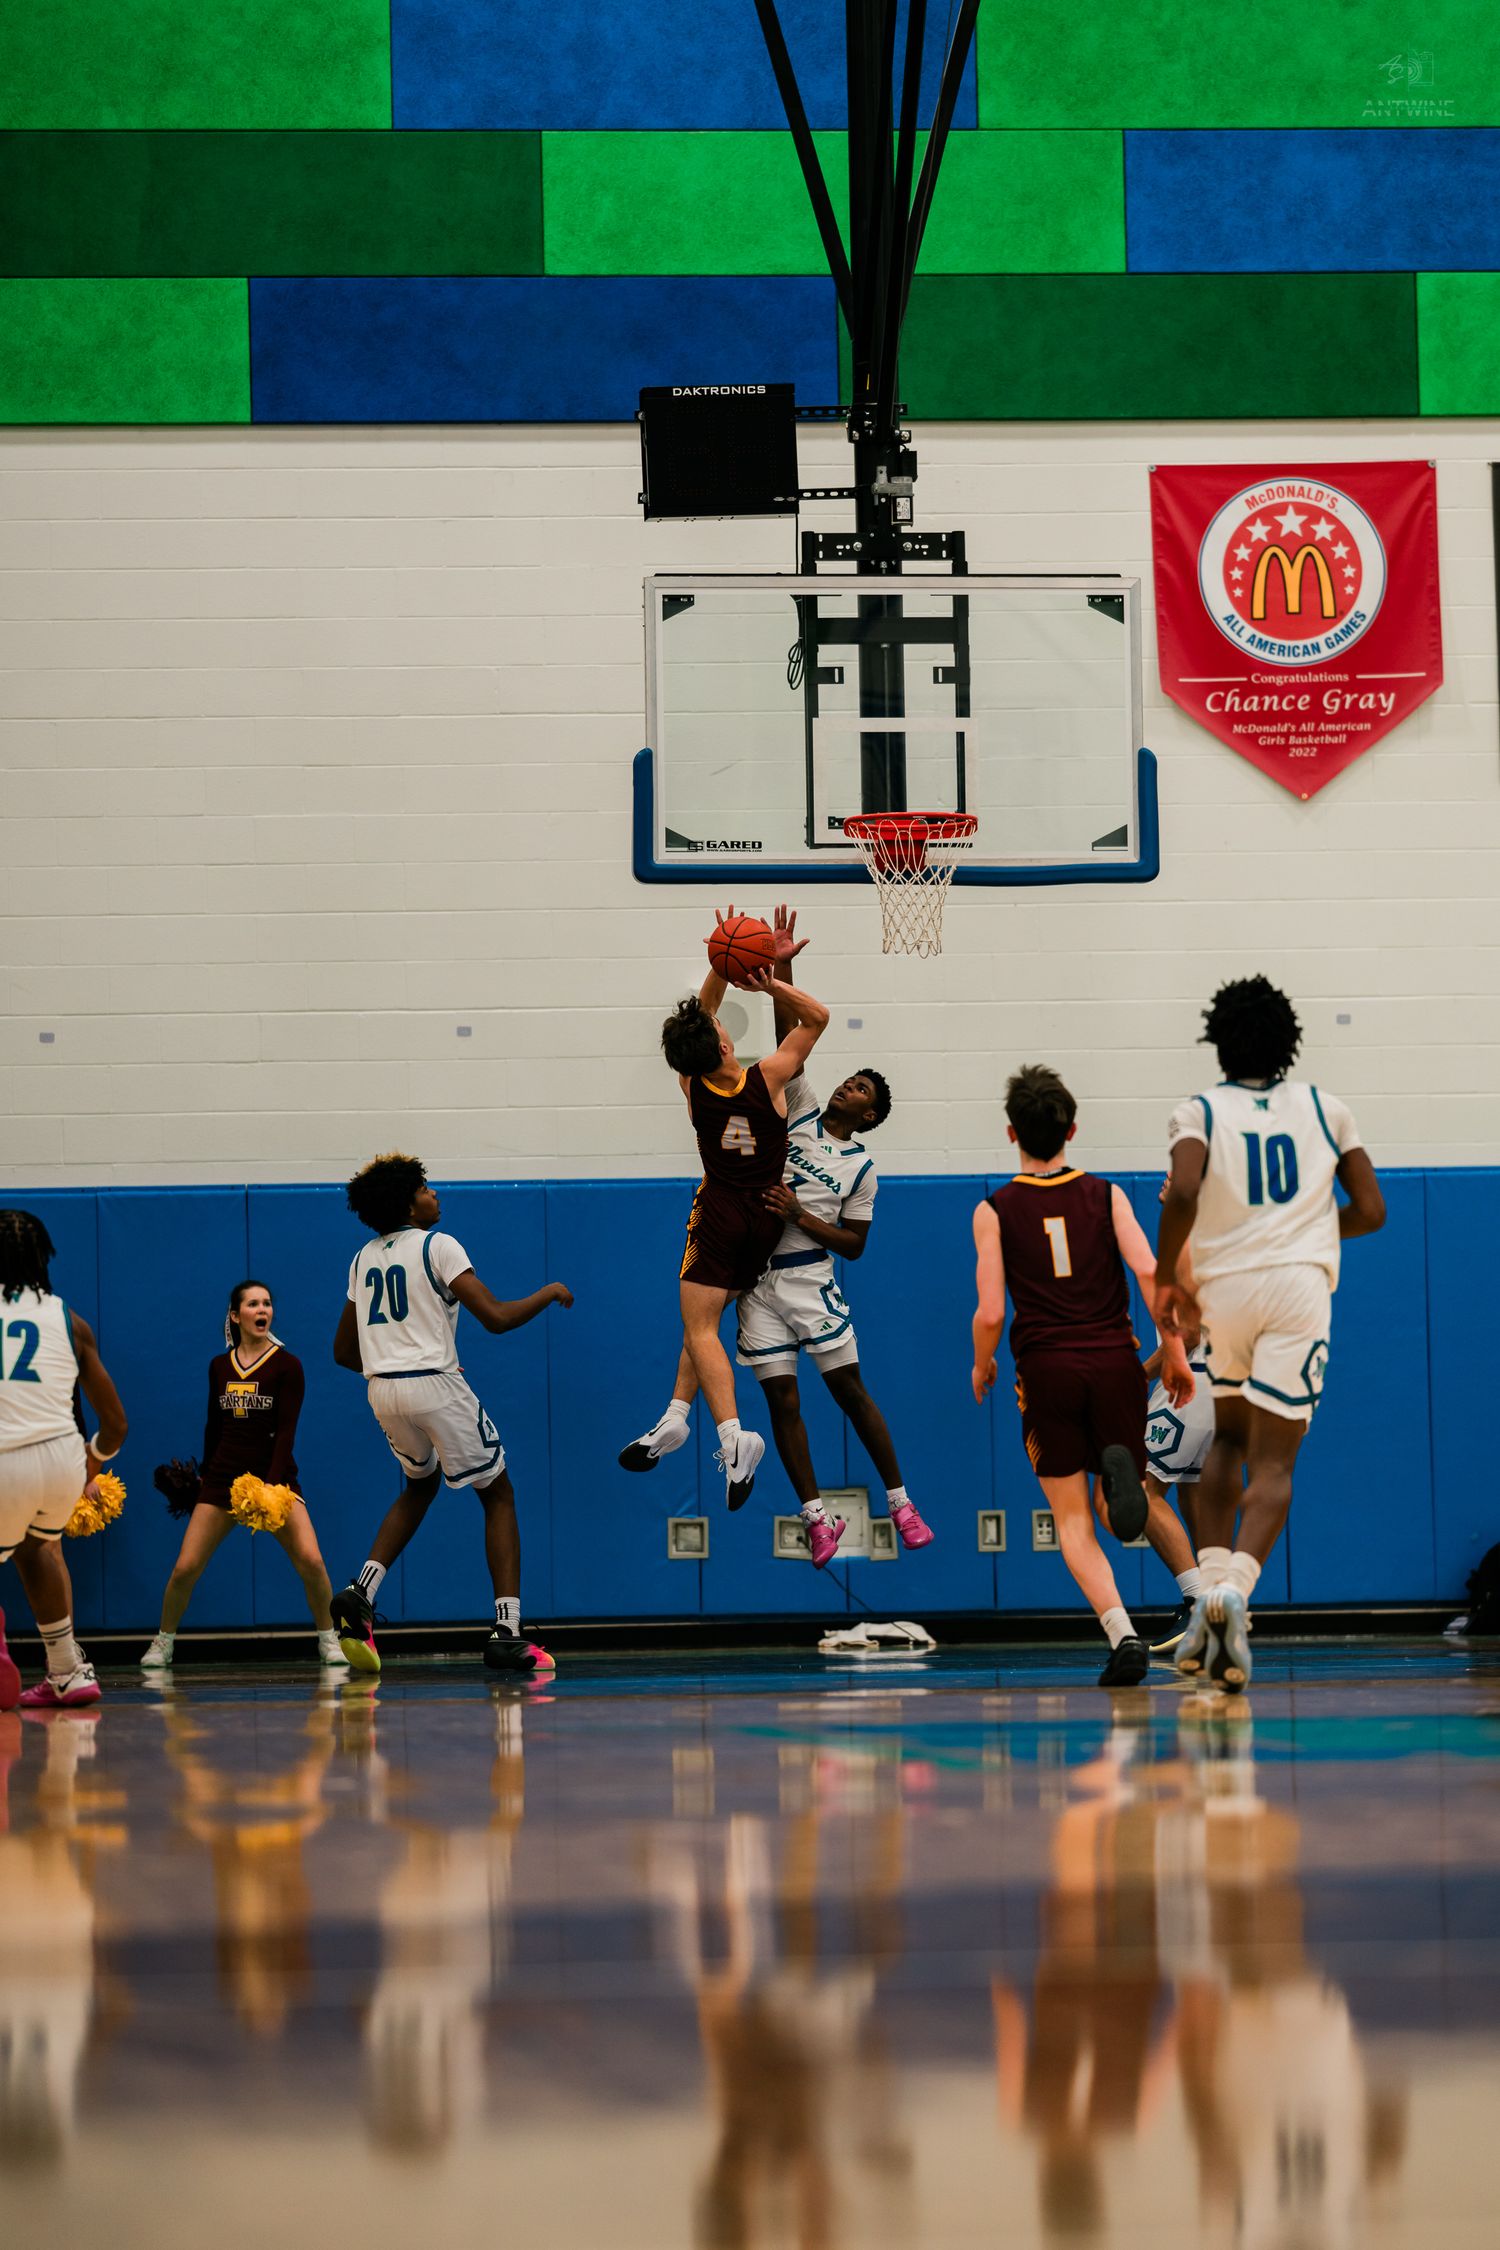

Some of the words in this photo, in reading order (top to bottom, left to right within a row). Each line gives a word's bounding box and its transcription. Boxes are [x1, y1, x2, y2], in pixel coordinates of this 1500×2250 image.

[672, 385, 766, 397] DAKTRONICS
[1223, 613, 1243, 638] ALL
[1246, 634, 1321, 658] AMERICAN
[1326, 610, 1367, 655] GAMES
[1251, 672, 1350, 685] Congratulations
[1205, 688, 1311, 713] Chance
[1322, 688, 1396, 716] Gray
[1232, 722, 1296, 733] McDonald's
[1299, 722, 1315, 733] All
[1317, 721, 1371, 732] American
[1258, 734, 1286, 746] Girls
[1289, 734, 1346, 745] Basketball
[1288, 747, 1317, 757] 2022
[706, 840, 762, 849] GARED
[720, 1115, 757, 1156] 4
[1241, 1132, 1299, 1205] 10
[1043, 1216, 1072, 1278] 1
[365, 1264, 409, 1326] 20
[219, 1394, 273, 1410] PARTANS
